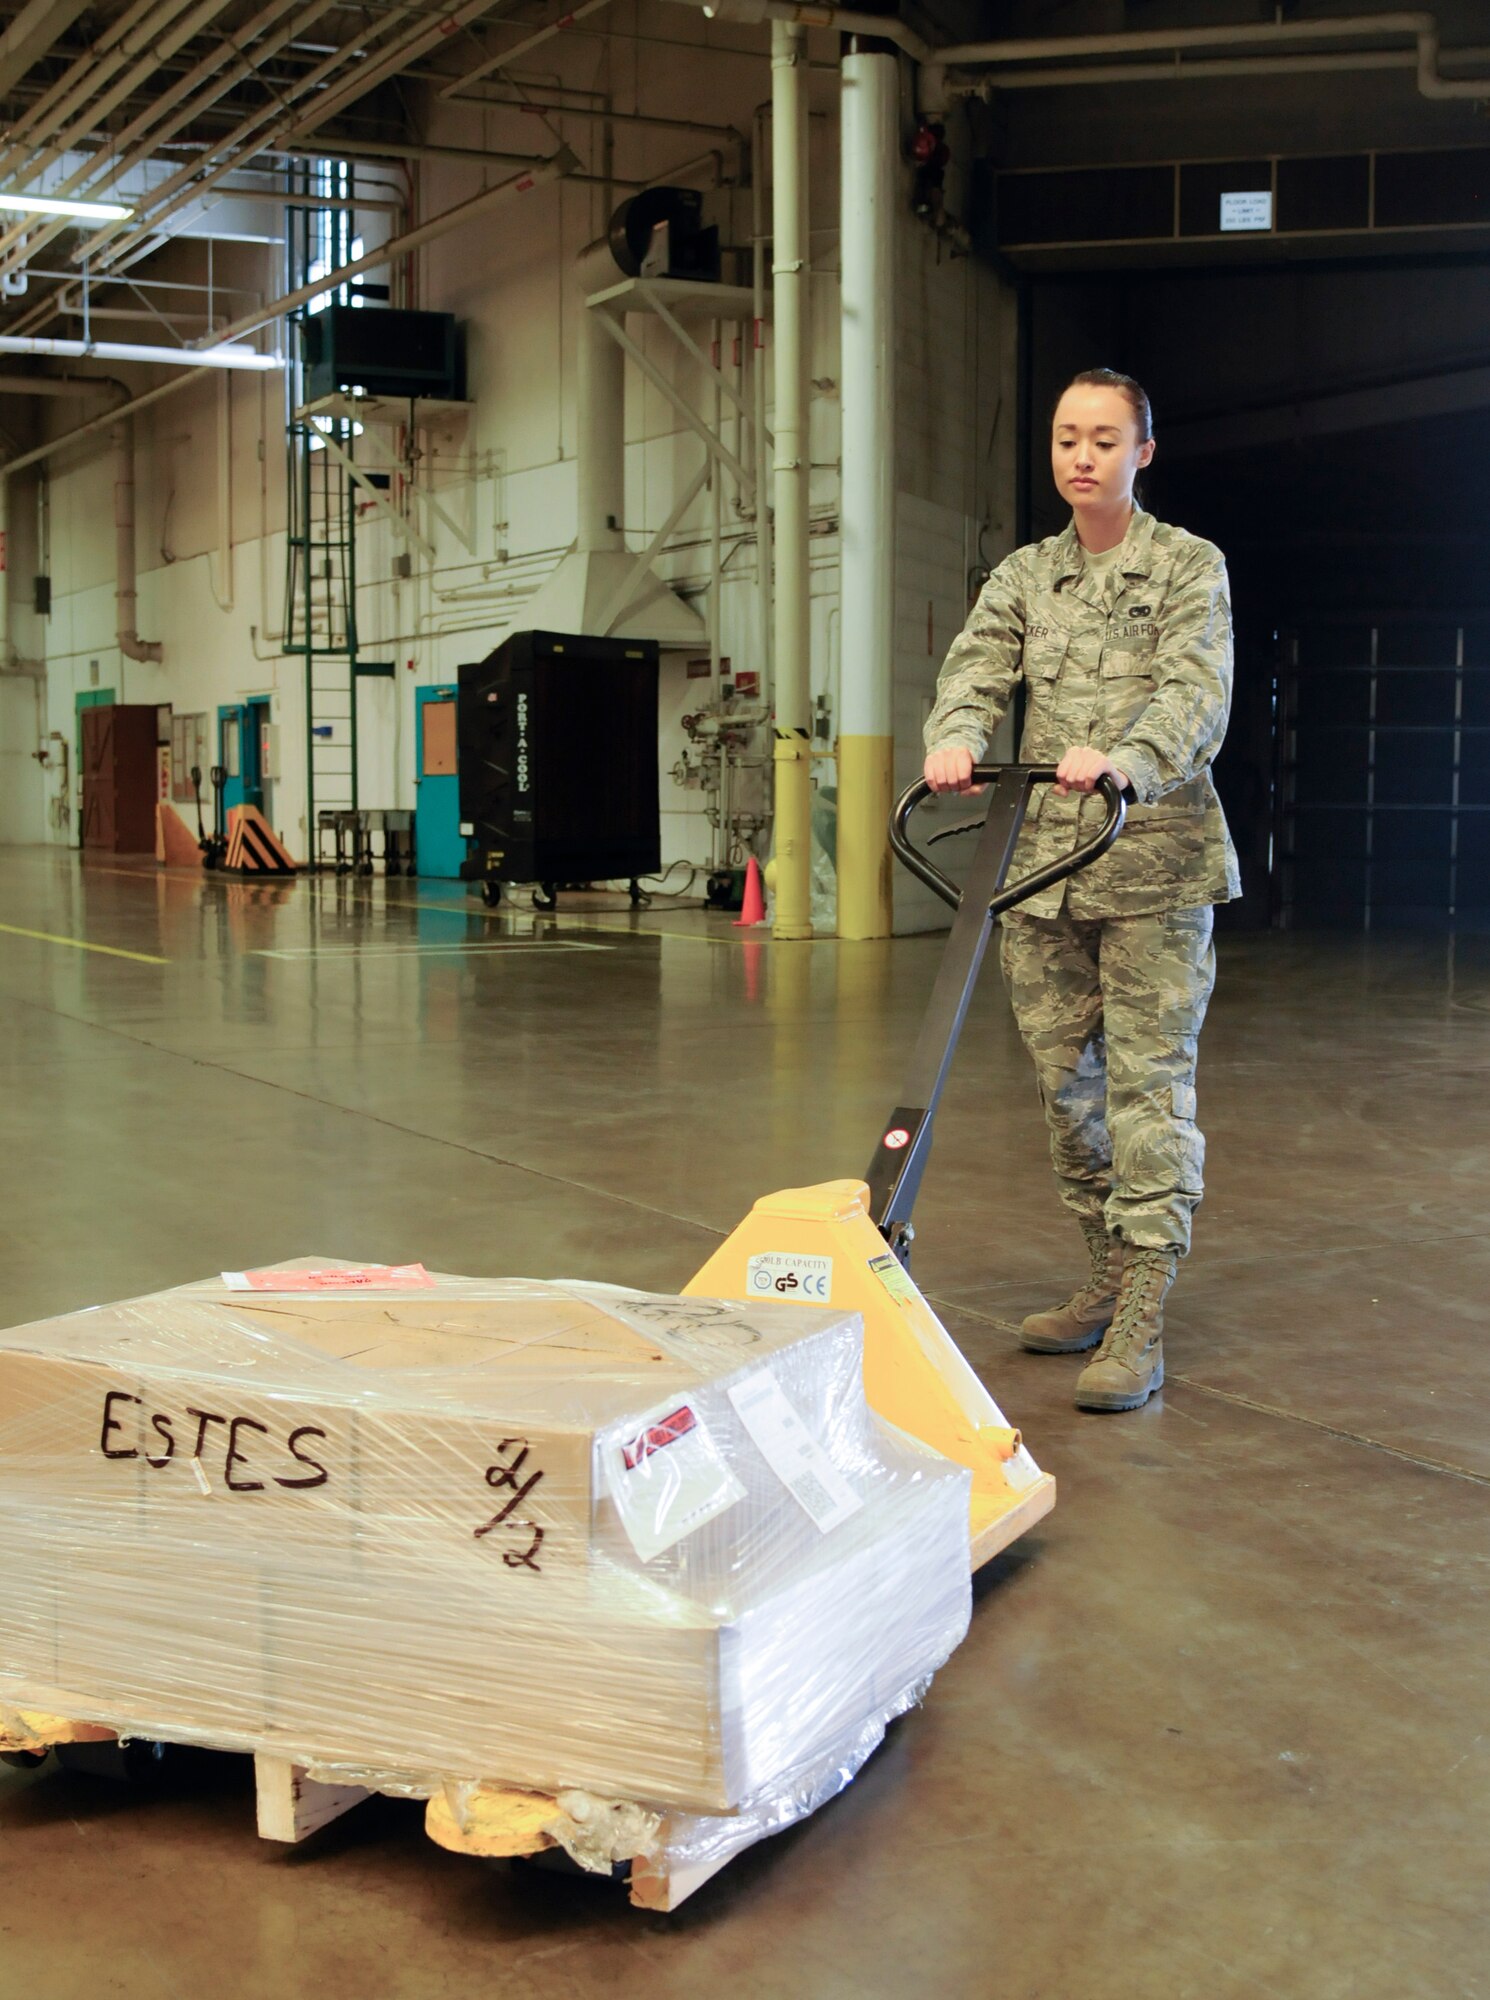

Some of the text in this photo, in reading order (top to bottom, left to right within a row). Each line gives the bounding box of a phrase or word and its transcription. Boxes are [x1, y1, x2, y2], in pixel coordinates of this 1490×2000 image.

[1123, 624, 1139, 638] AIR
[785, 1258, 827, 1270] CAPACITY
[775, 1272, 799, 1293] GS
[802, 1274, 827, 1297] CE
[101, 1391, 328, 1489] ESTES
